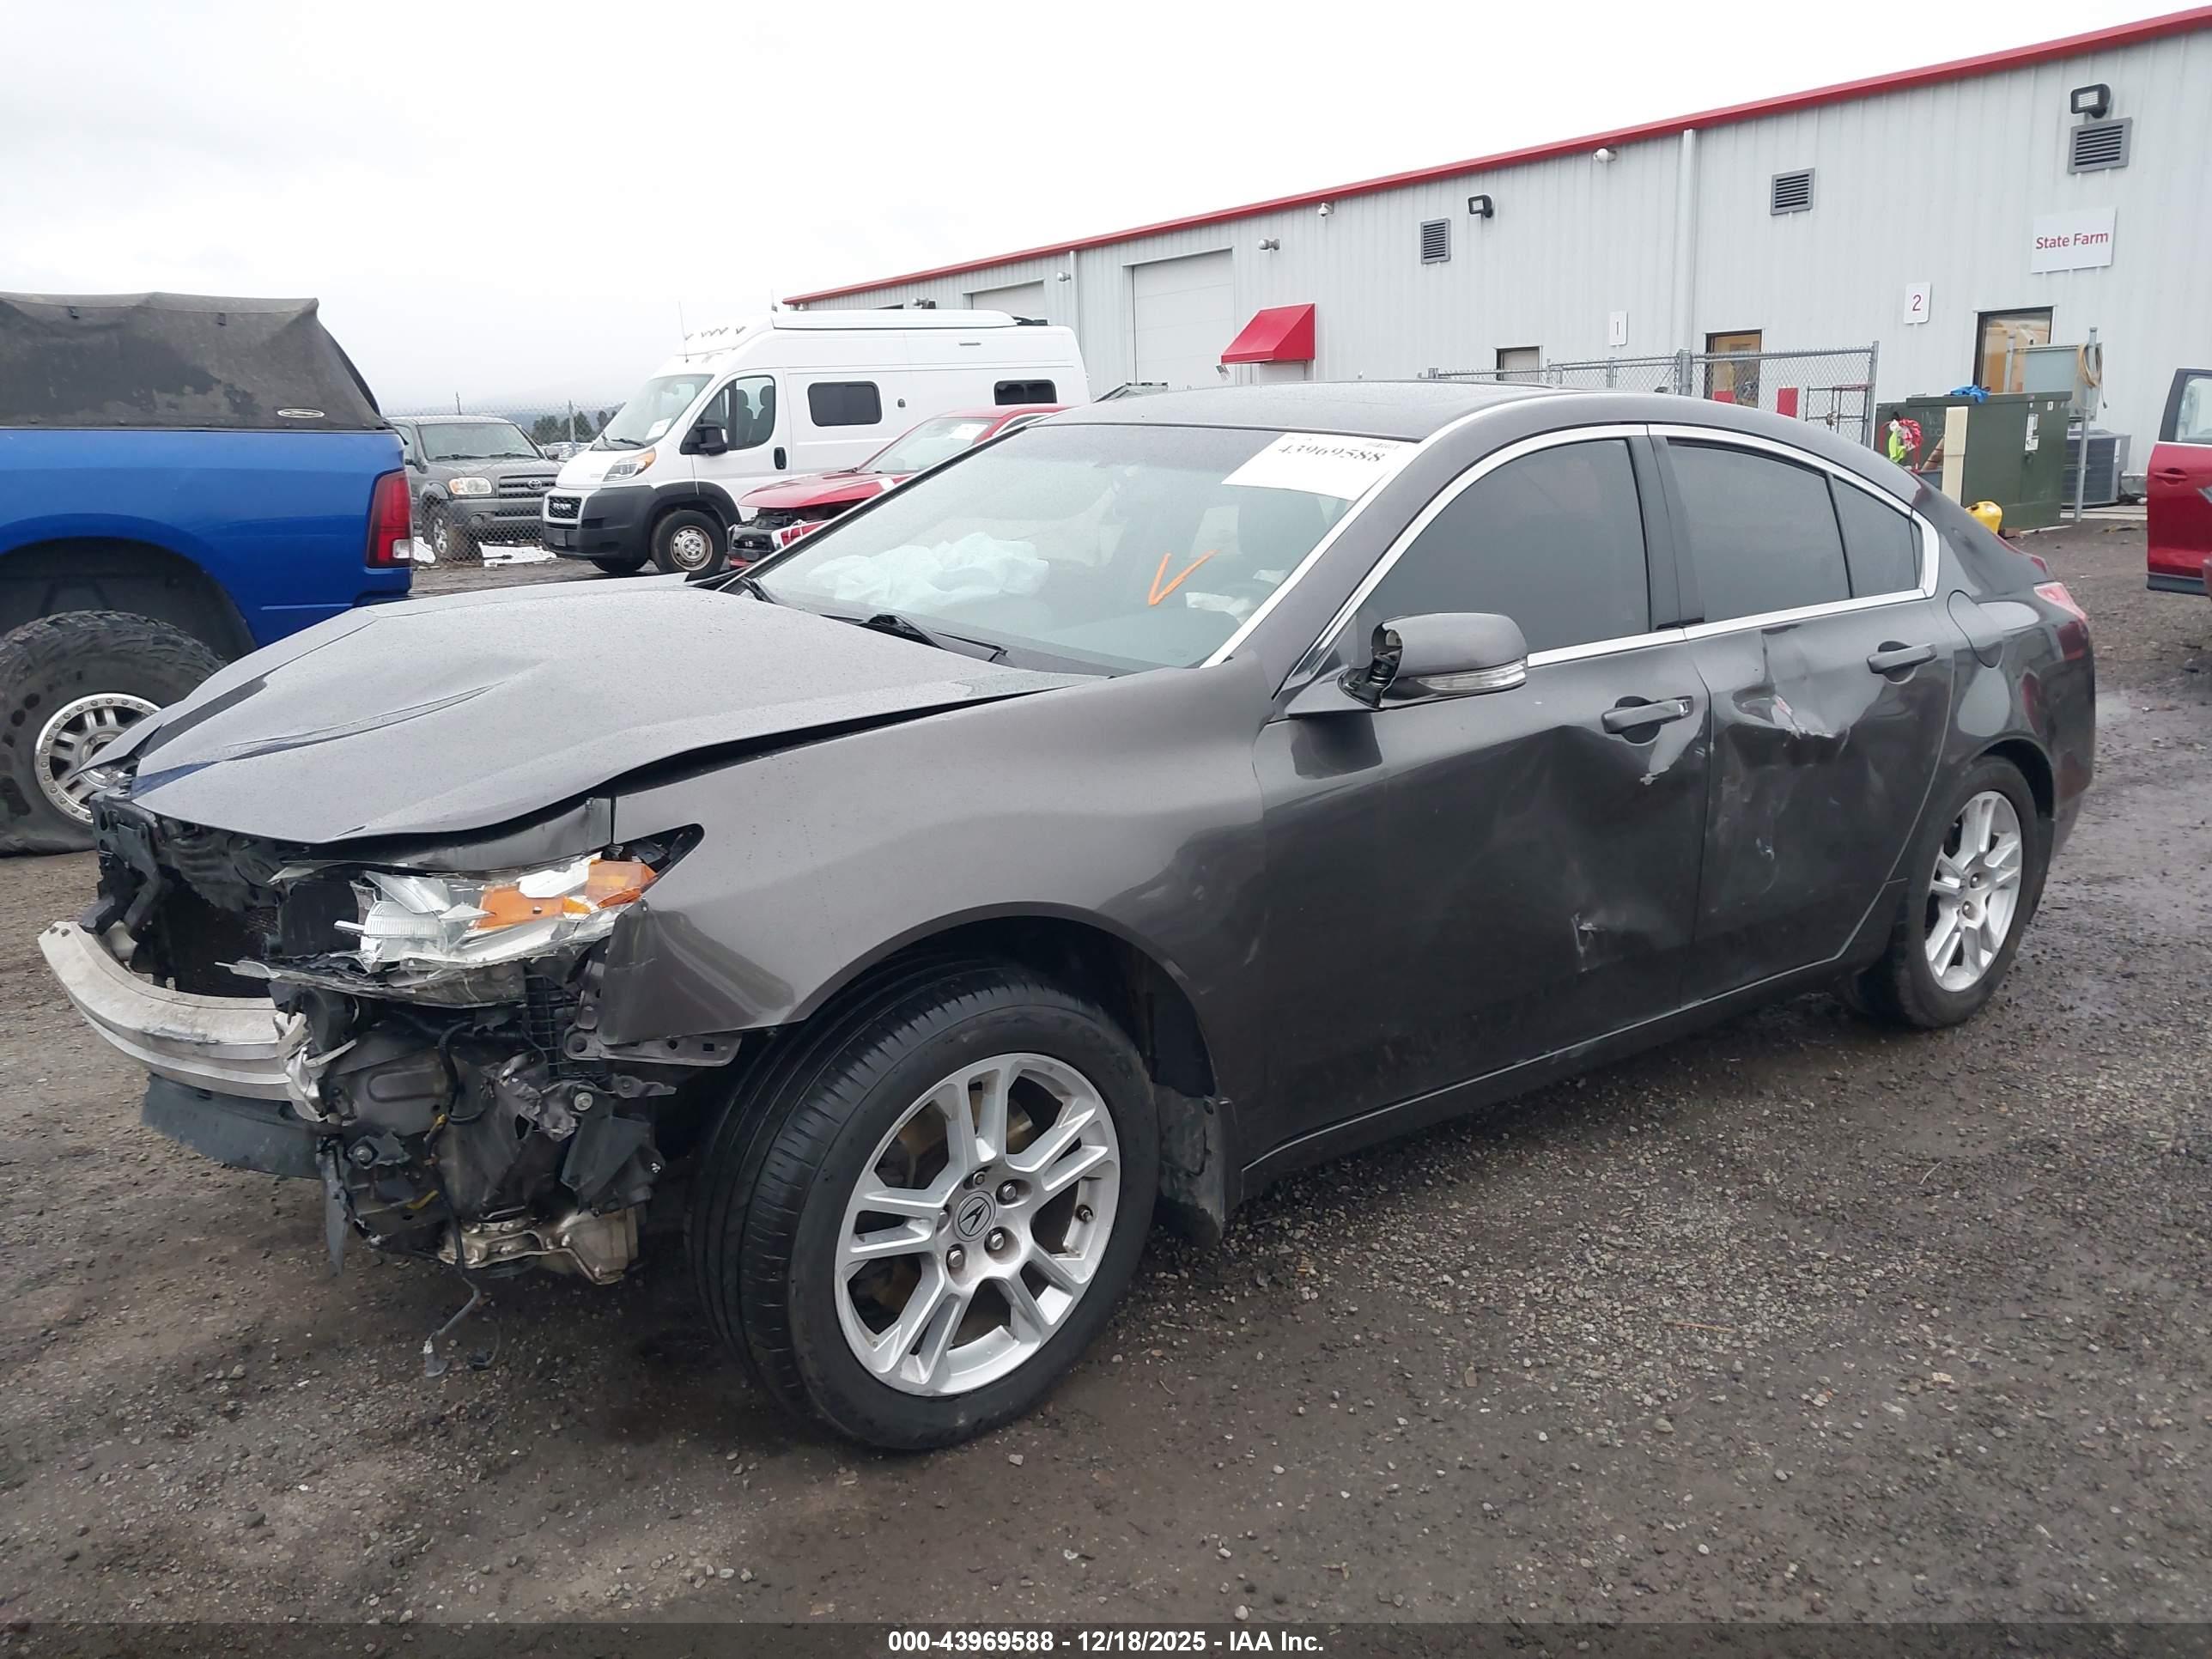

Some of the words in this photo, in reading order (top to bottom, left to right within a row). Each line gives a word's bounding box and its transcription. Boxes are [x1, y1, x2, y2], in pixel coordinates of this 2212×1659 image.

[2035, 235, 2070, 250] State
[2073, 233, 2109, 246] Farm
[1912, 294, 1922, 312] 2
[1278, 444, 1386, 462] 43969588
[552, 502, 572, 511] RAM
